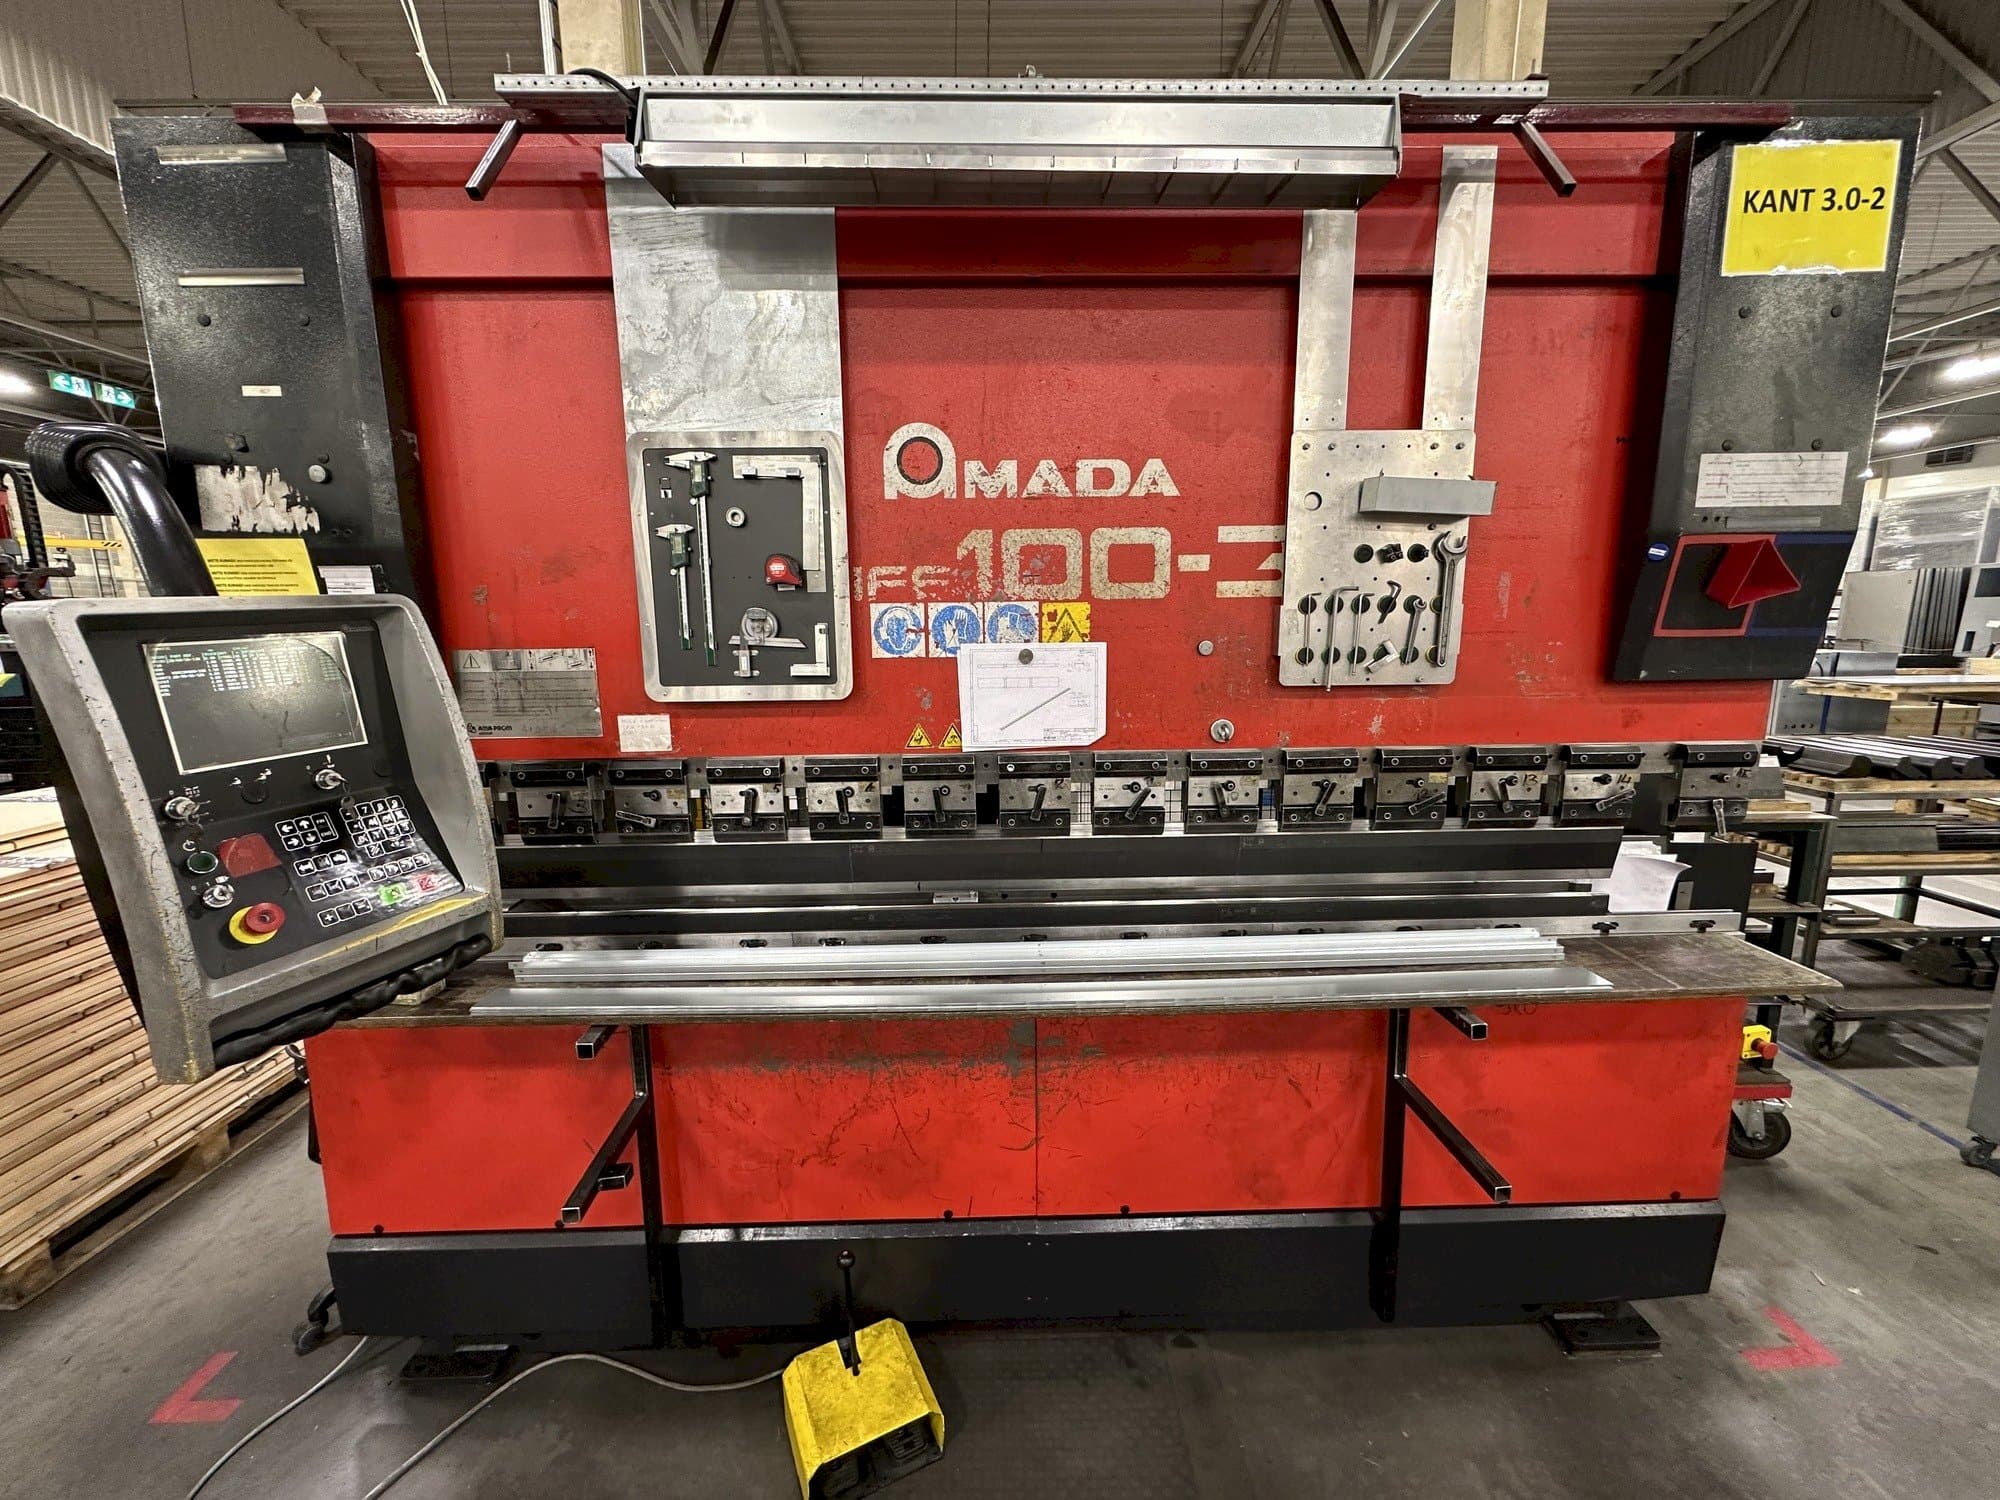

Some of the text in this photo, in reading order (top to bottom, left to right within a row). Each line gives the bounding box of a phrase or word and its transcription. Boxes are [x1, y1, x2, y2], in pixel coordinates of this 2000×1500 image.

[1743, 186, 1886, 213] KANT 3.0-2
[884, 422, 1180, 499] AMADA
[1522, 773, 1539, 787] 13
[1616, 773, 1632, 785] 14
